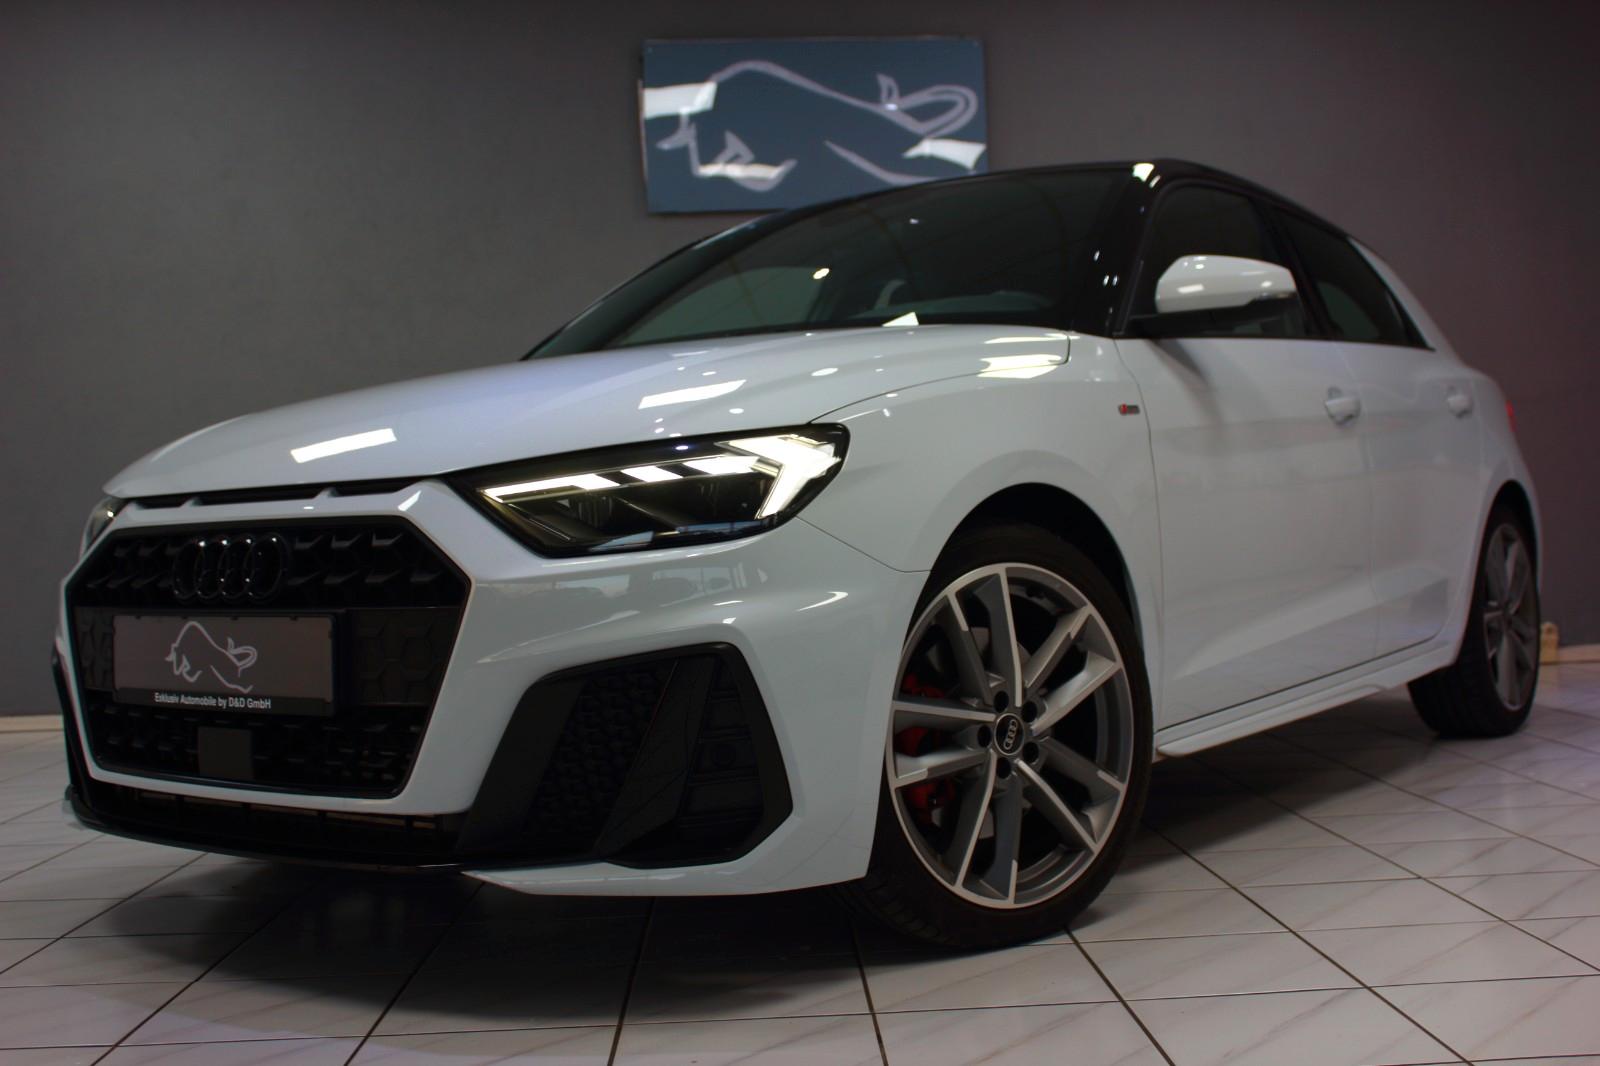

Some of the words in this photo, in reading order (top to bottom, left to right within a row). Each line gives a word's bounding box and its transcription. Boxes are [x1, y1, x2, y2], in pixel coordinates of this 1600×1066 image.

[180, 694, 217, 706] Automobile
[218, 696, 227, 709] by
[228, 697, 245, 708] D&D
[247, 698, 271, 709] GmbH
